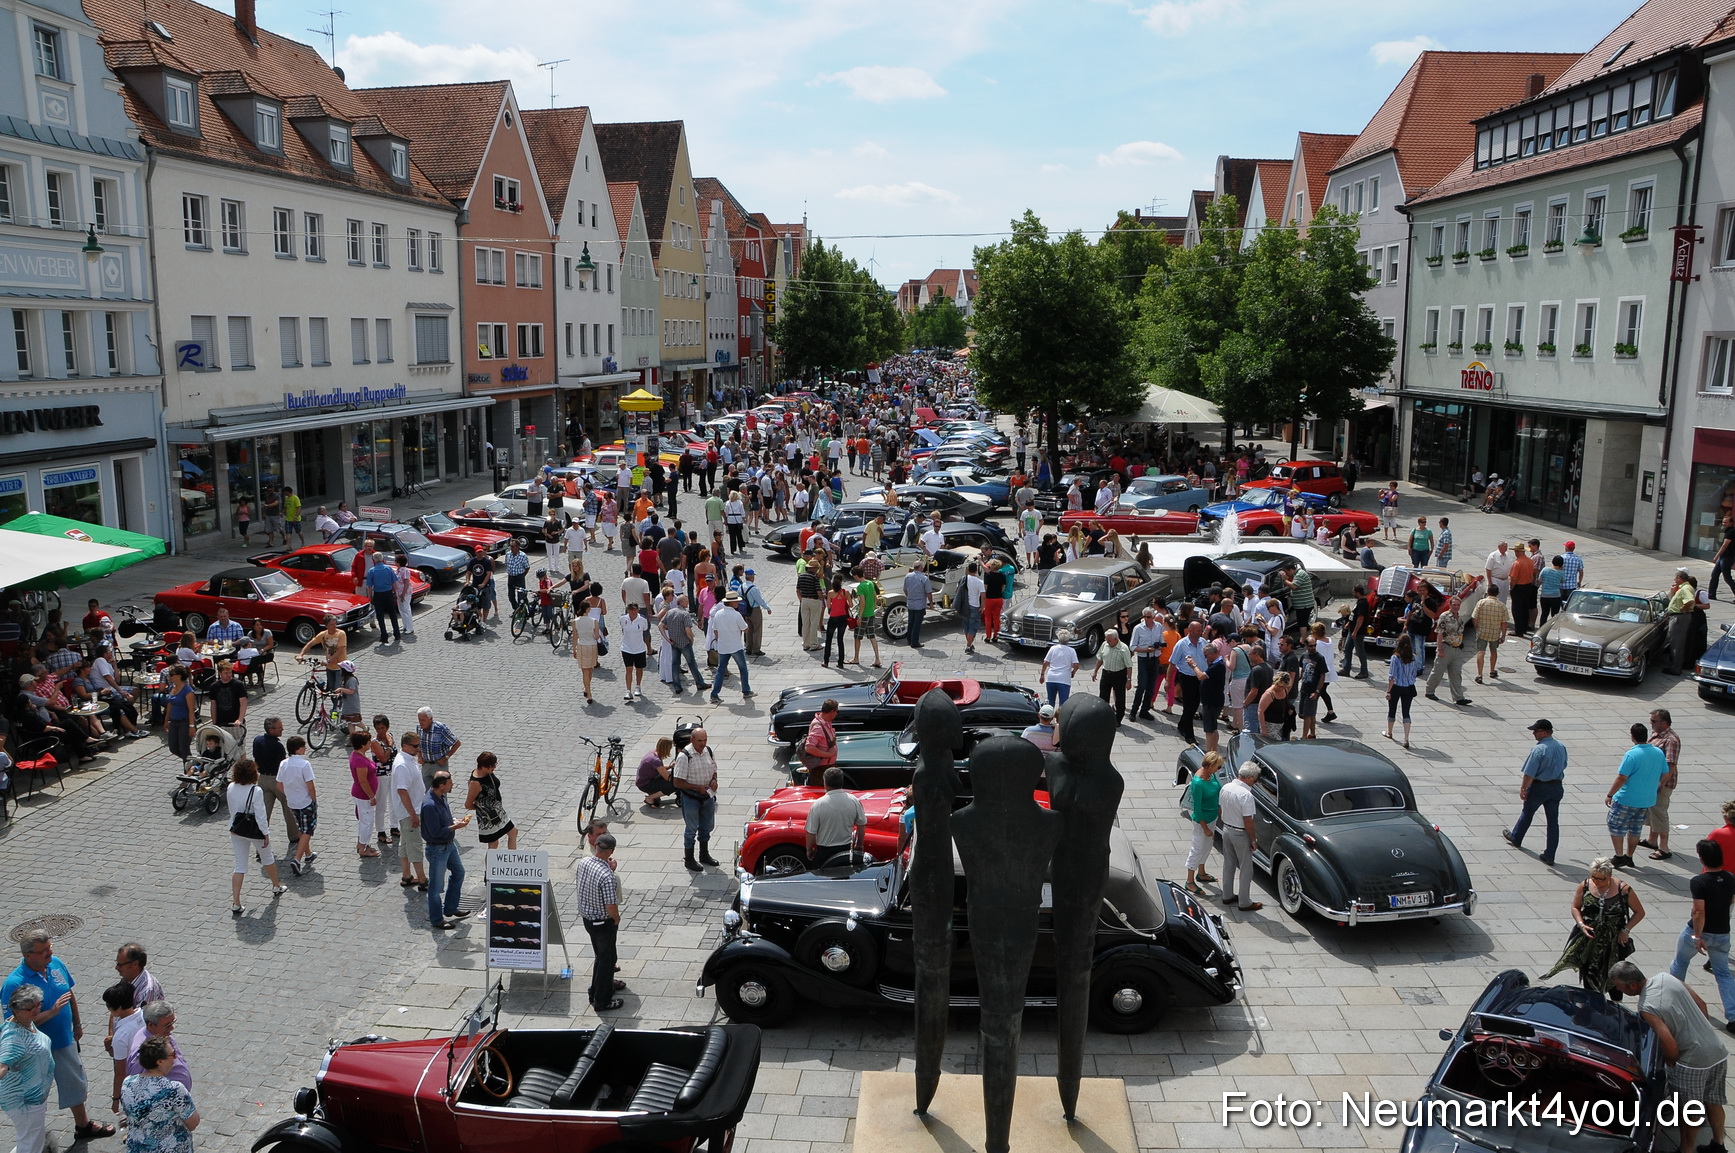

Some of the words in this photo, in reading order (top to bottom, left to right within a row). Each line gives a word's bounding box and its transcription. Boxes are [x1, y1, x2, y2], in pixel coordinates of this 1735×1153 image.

[20, 254, 77, 278] WEBER
[1677, 237, 1690, 277] Achatz
[765, 281, 775, 332] HOTE
[1461, 369, 1493, 391] RENO
[286, 387, 360, 409] Buchhandlung
[362, 383, 407, 404] Rupprecht
[34, 405, 104, 431] WEBER
[71, 469, 94, 481] WEBER
[496, 854, 537, 863] WELTWEIT
[491, 867, 543, 877] EINZIGARTIG
